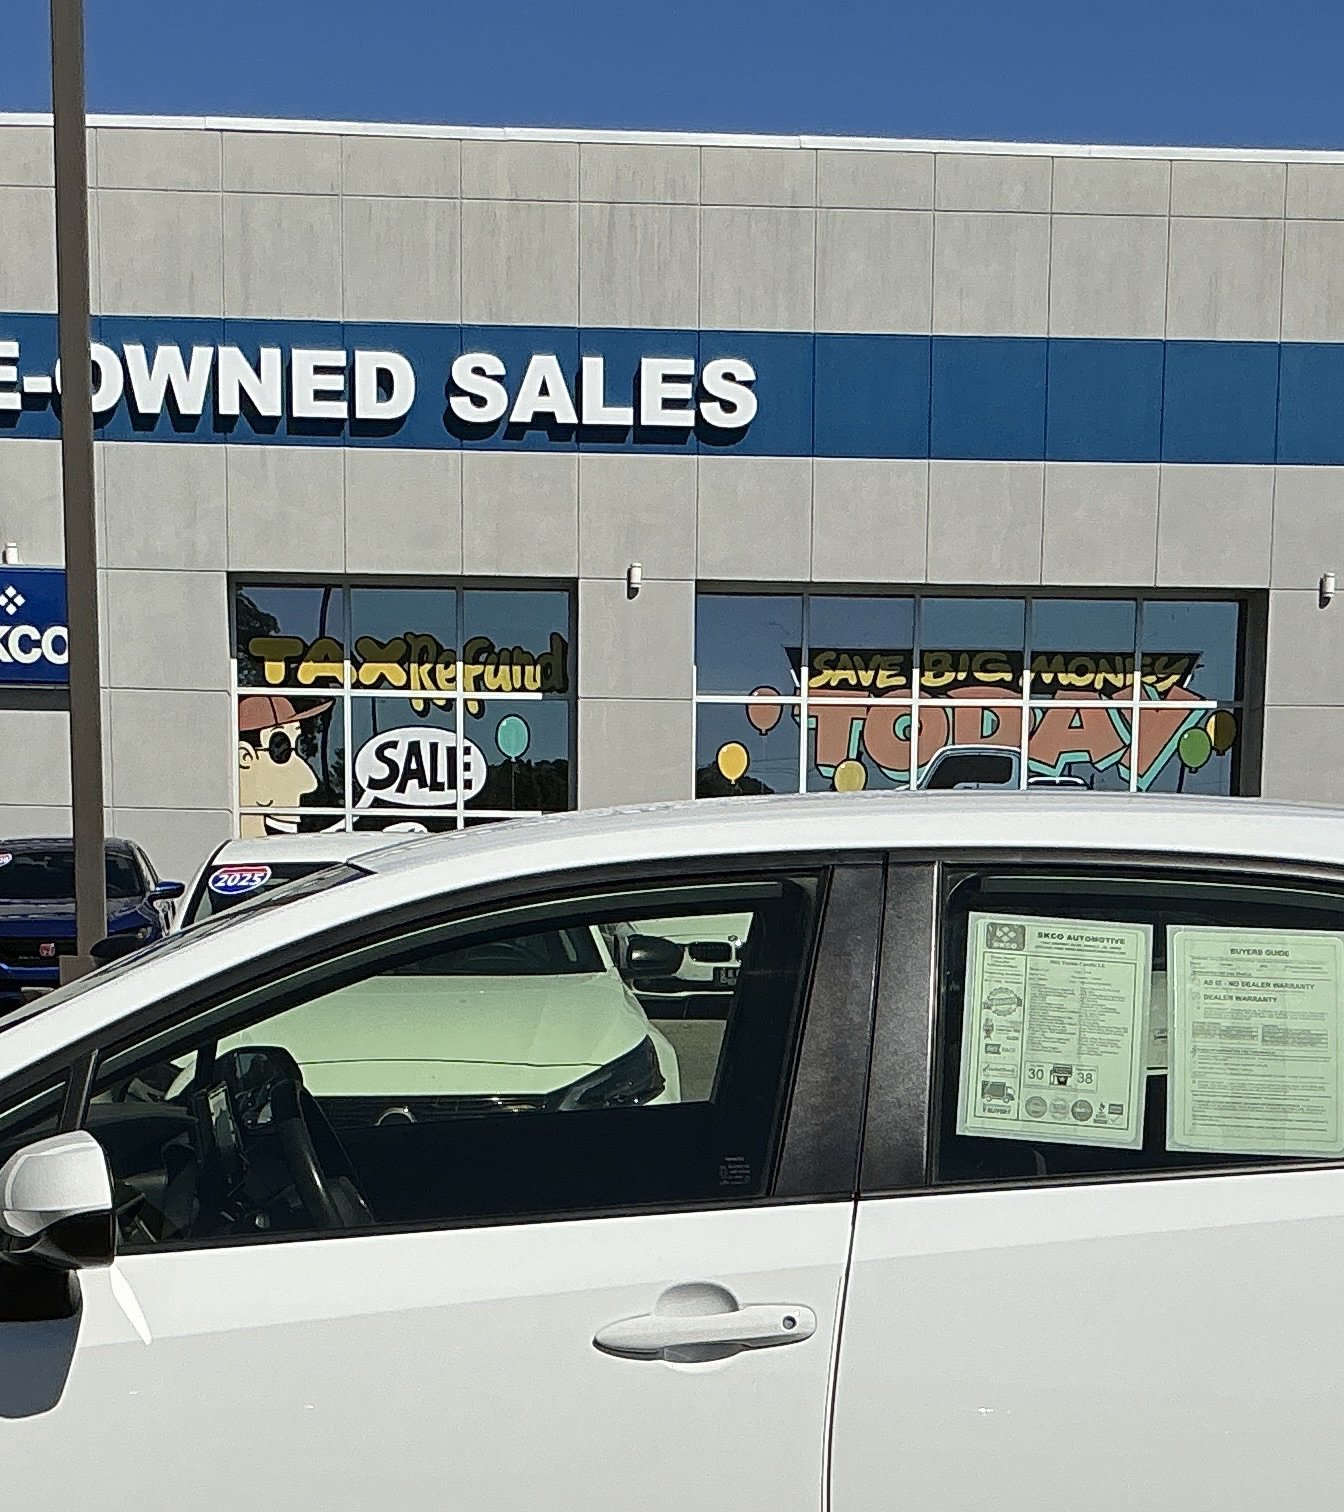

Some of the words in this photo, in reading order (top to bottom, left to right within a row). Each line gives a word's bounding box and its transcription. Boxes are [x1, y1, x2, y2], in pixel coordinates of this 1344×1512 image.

[449, 351, 758, 428] SALES
[248, 636, 407, 686] TAX
[808, 650, 907, 687] SAVE
[920, 651, 1013, 687] BIG
[1020, 654, 1190, 691] MONEY
[794, 685, 1208, 792] TODAY
[367, 740, 473, 793] SALE
[214, 872, 265, 886] 2025
[1037, 931, 1064, 940] SKCO
[1273, 982, 1316, 990] WARRANTY
[1028, 1068, 1044, 1080] 30
[1077, 1072, 1093, 1084] 38
